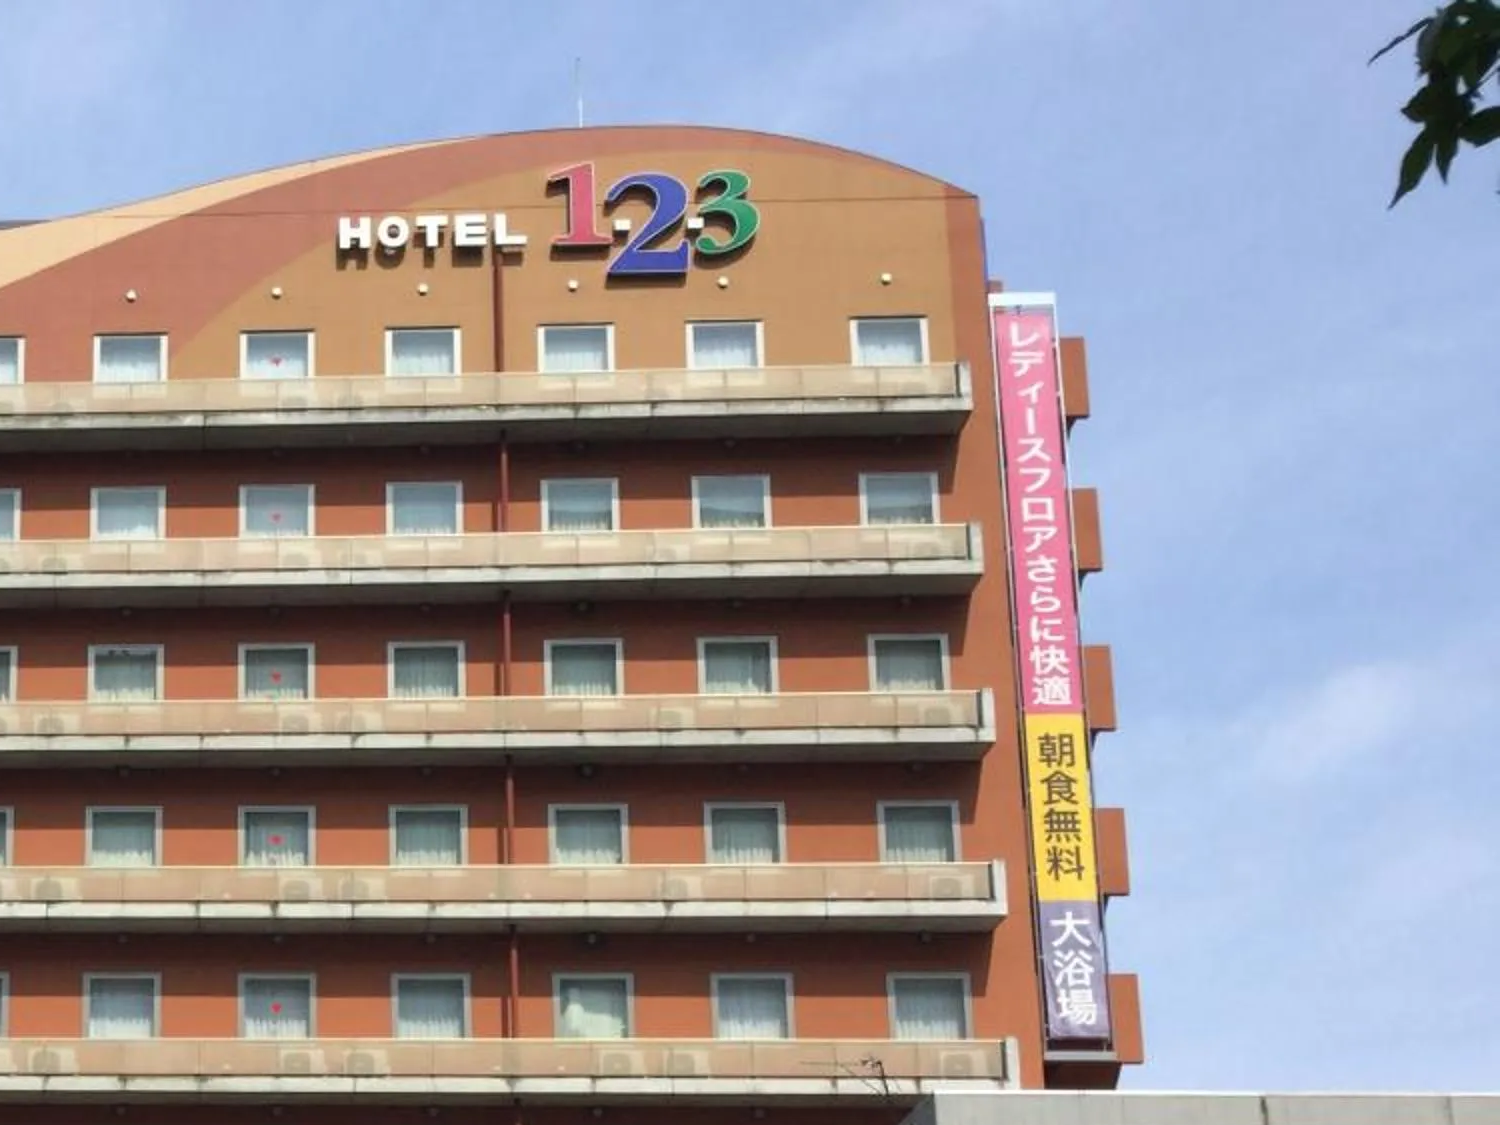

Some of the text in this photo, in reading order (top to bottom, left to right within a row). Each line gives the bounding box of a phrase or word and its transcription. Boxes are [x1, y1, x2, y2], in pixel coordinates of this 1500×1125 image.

[338, 213, 527, 250] HOTEL
[1008, 320, 1073, 706] レディースフロアさらに快適
[1037, 731, 1085, 881] 朝食無料
[1050, 911, 1098, 1026] 大浴場
